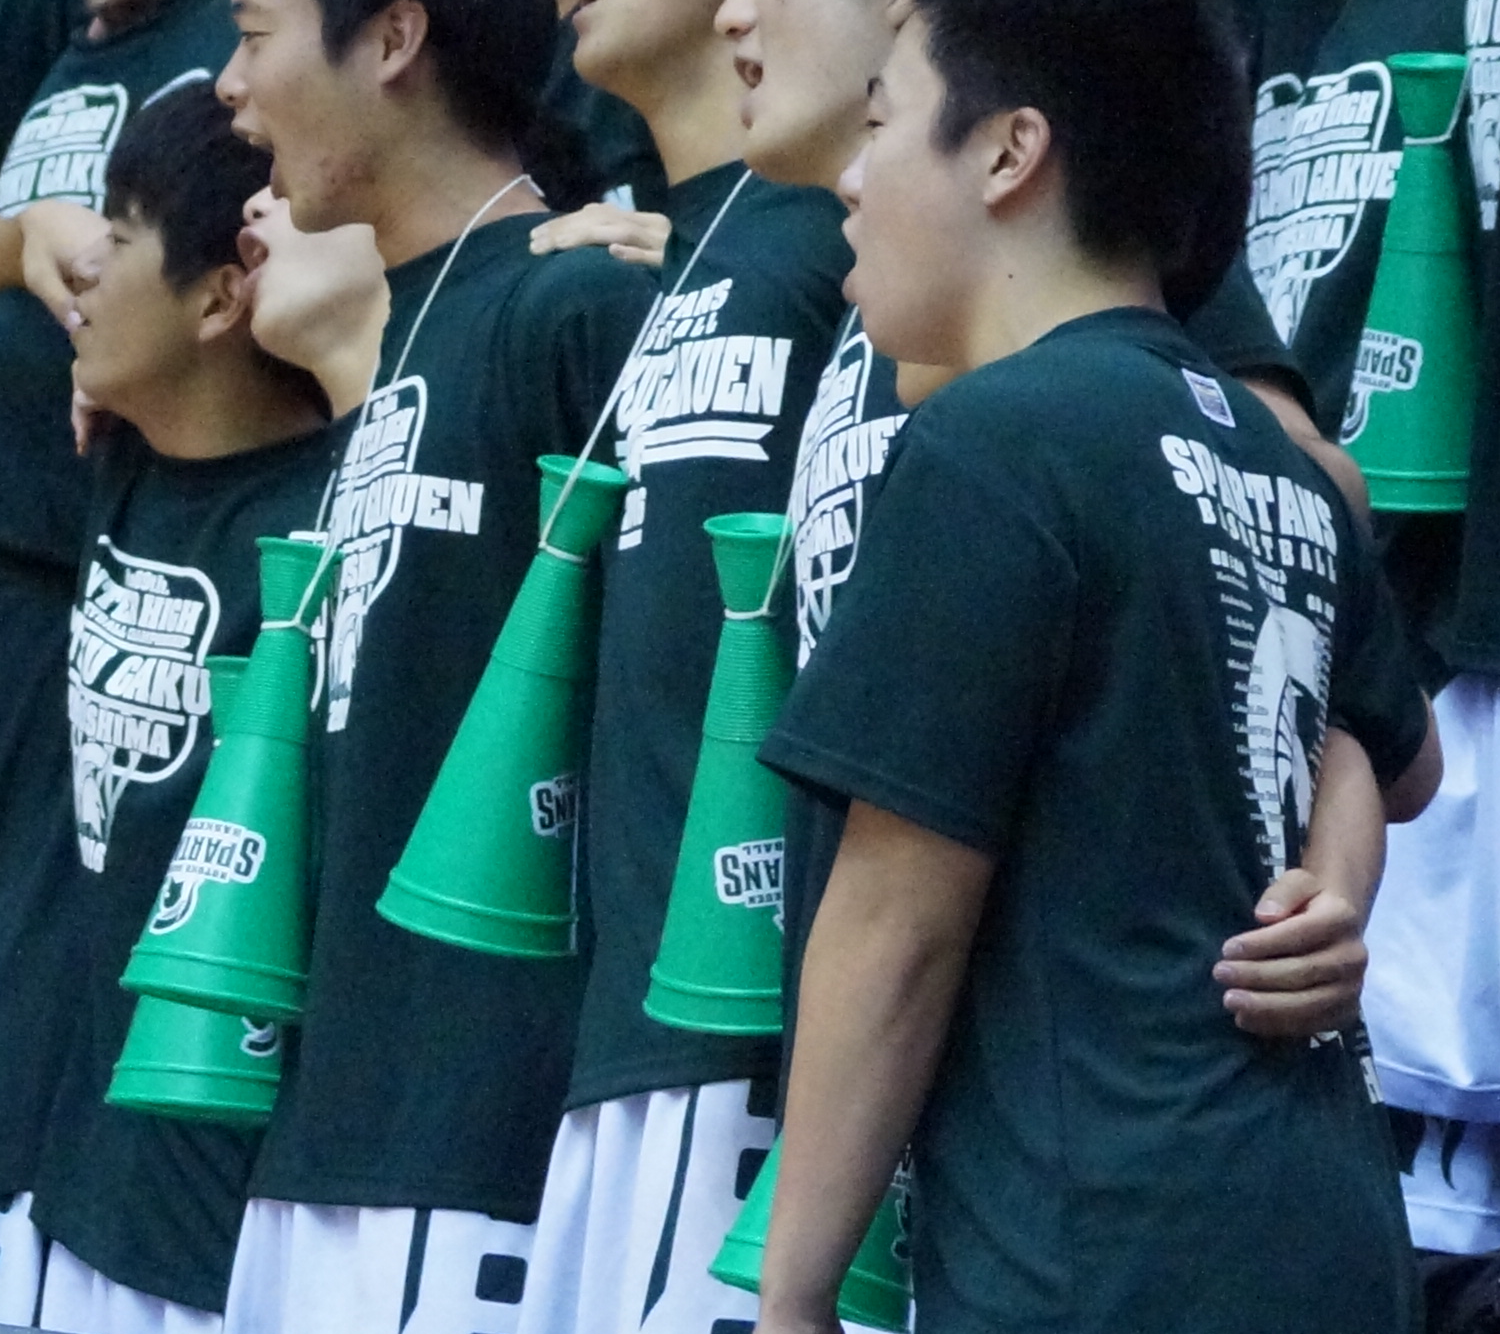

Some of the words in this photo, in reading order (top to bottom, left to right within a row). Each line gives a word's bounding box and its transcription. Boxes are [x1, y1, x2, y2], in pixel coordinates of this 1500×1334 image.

[1306, 150, 1404, 206] GAKUE
[1160, 433, 1338, 558] SPARTANS
[104, 652, 212, 718] GAKU
